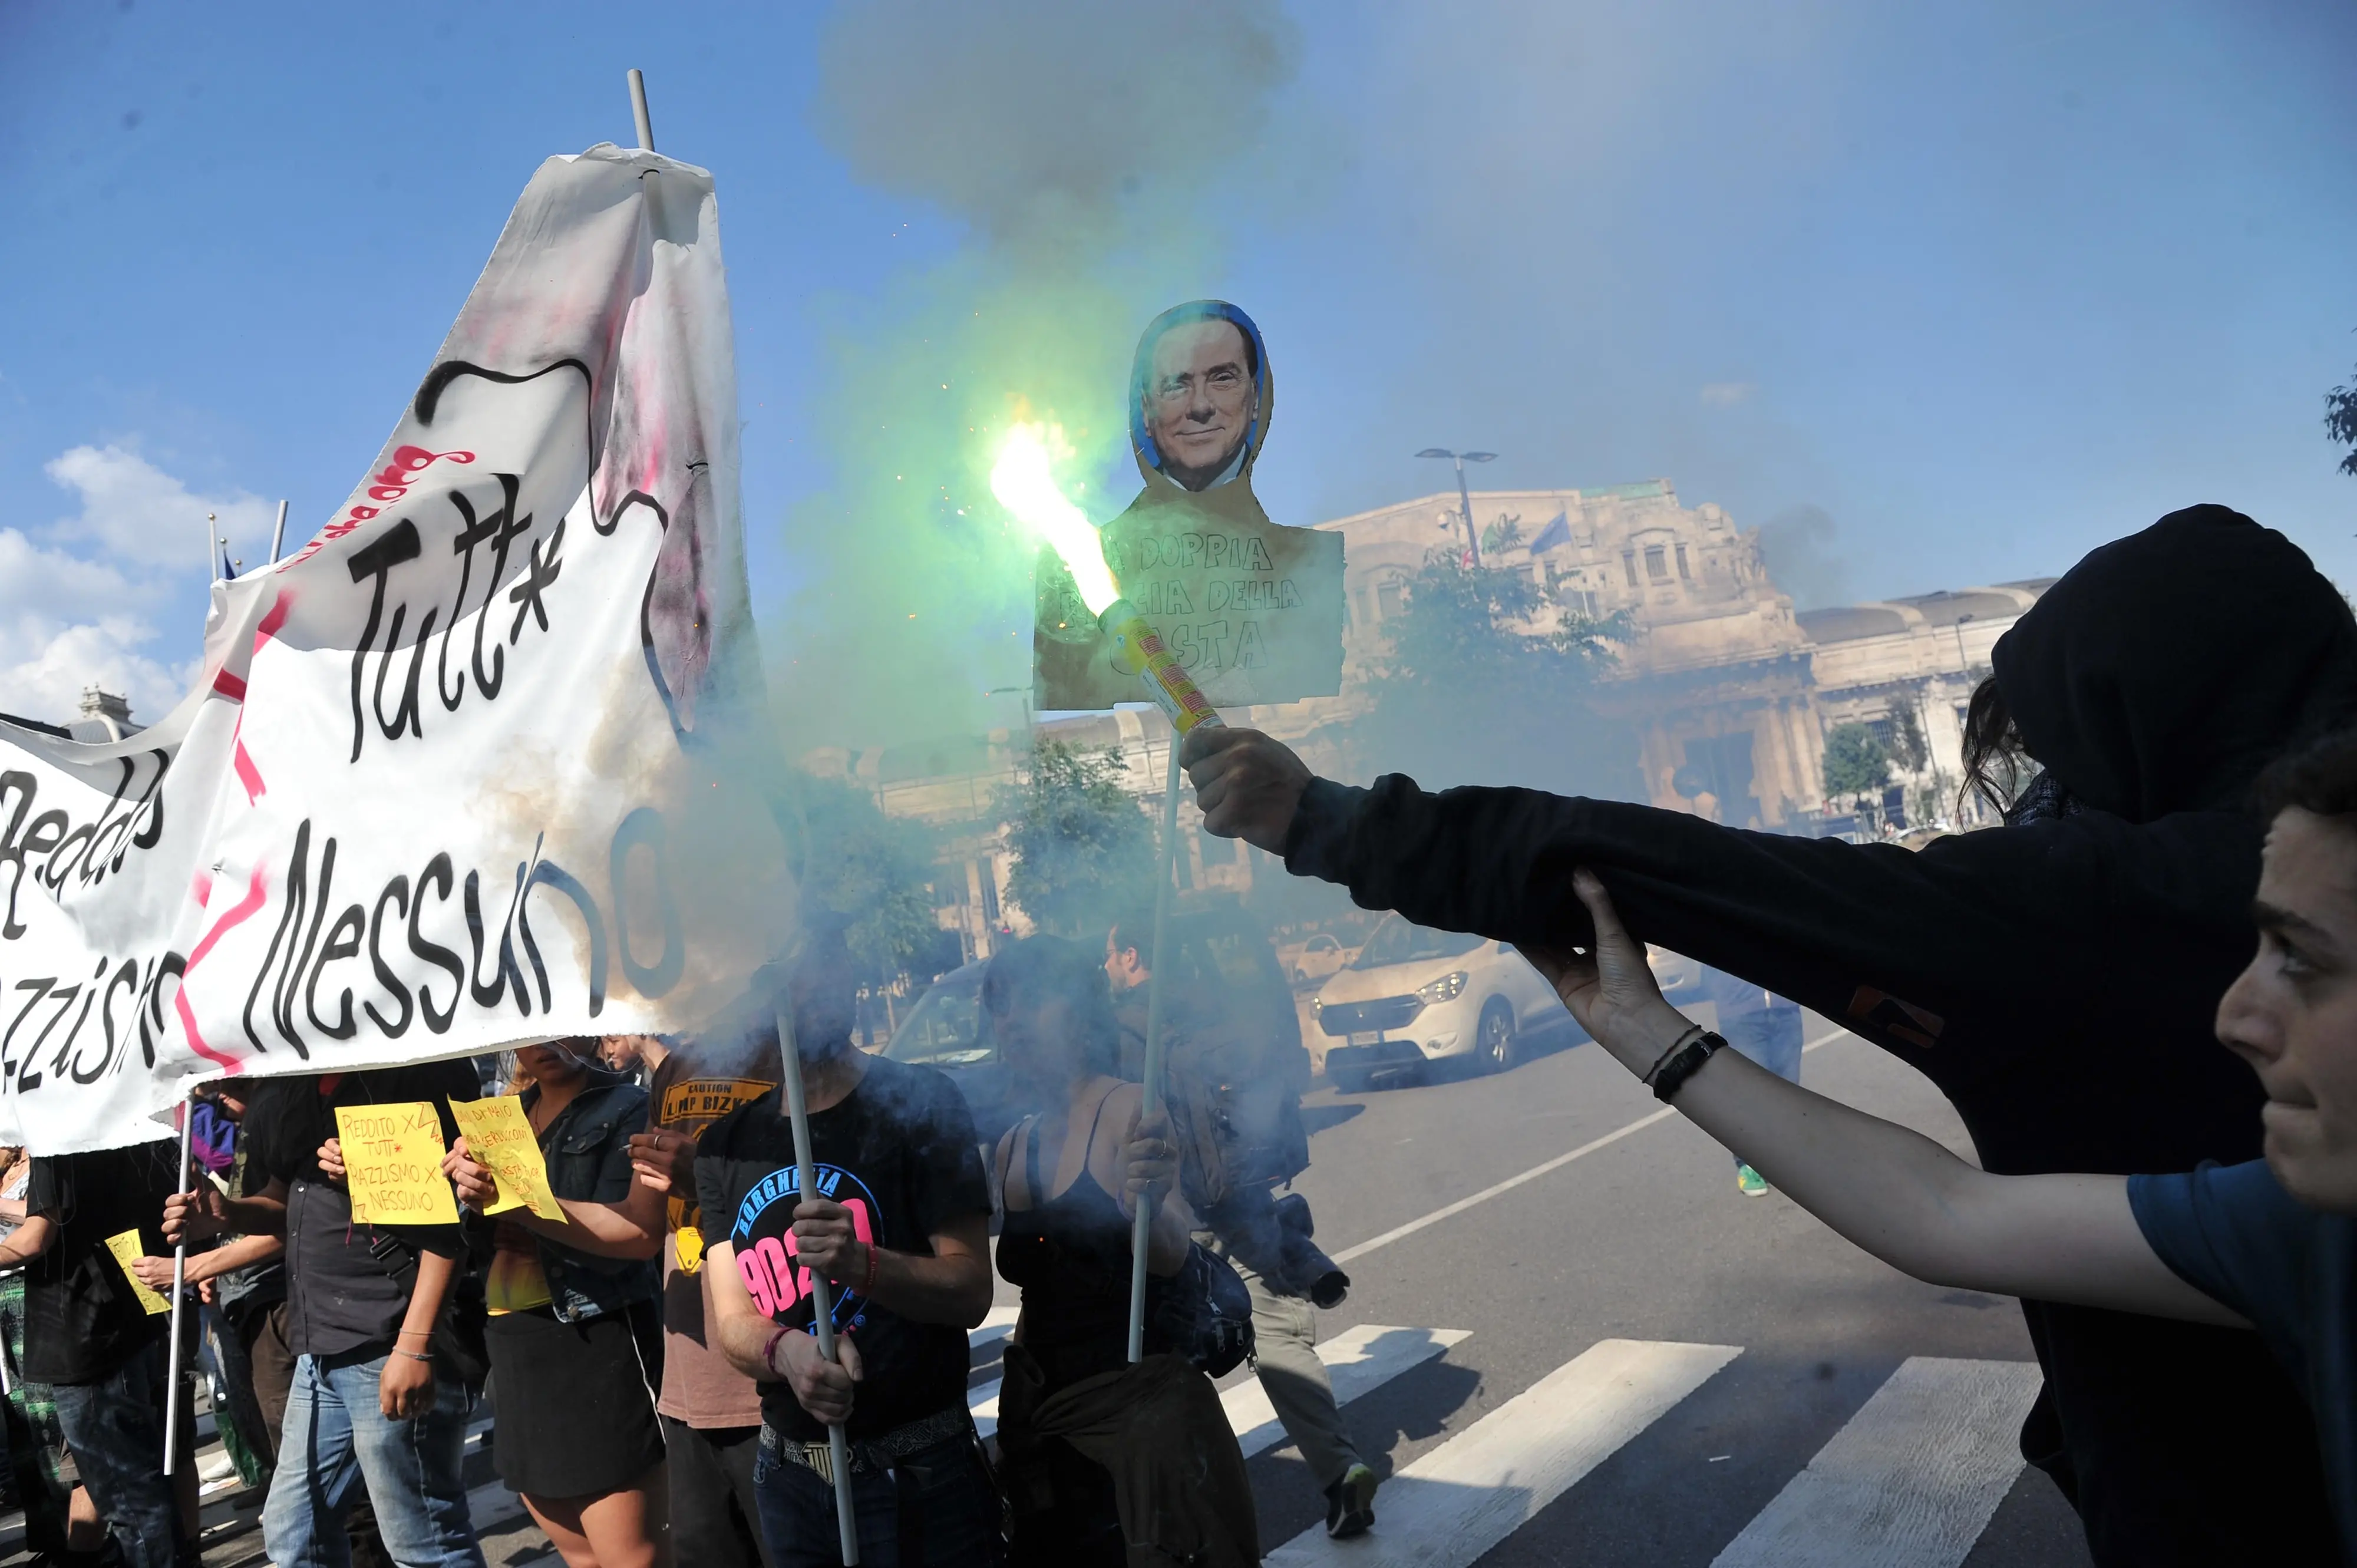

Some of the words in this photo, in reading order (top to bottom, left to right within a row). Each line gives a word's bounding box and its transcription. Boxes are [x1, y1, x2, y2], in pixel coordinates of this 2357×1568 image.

[1141, 533, 1273, 570] DOPPIA
[1208, 579, 1303, 611] DELLA
[242, 807, 685, 1060] Nessuno
[688, 1084, 732, 1094] CAUTION
[342, 1114, 395, 1146] REDDITO
[401, 1114, 418, 1134] X
[349, 1163, 420, 1188] RAZZISMO
[425, 1166, 437, 1184] X
[369, 1190, 434, 1212] NESSUNO
